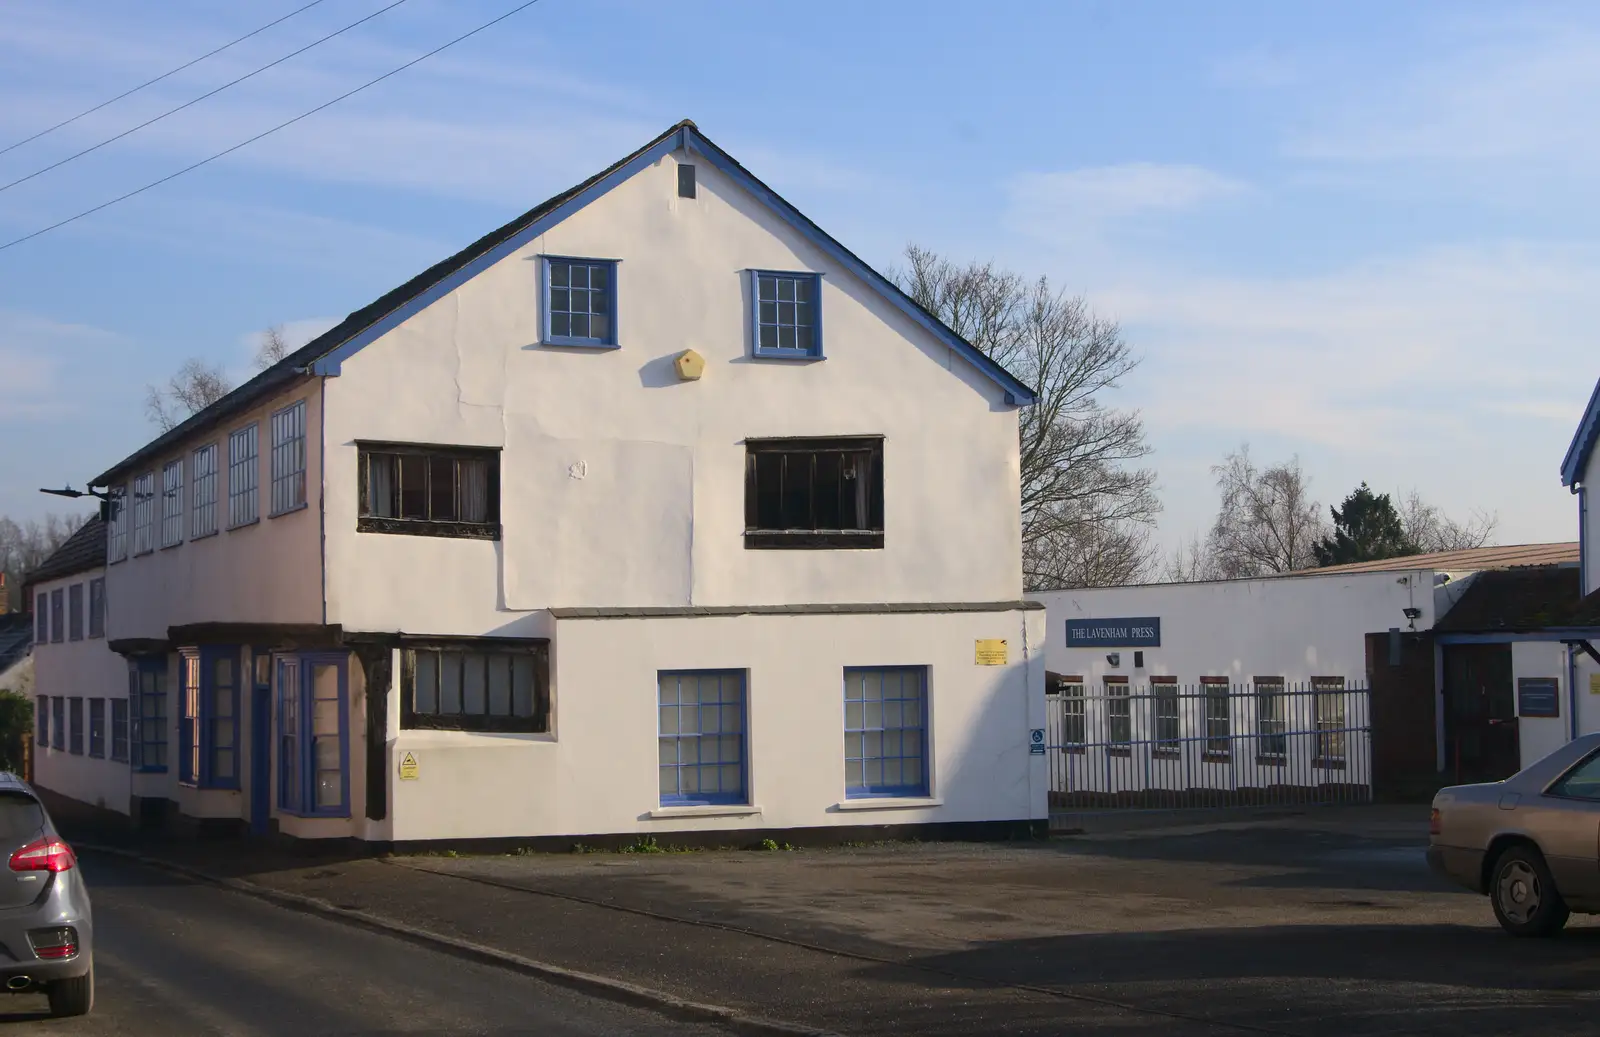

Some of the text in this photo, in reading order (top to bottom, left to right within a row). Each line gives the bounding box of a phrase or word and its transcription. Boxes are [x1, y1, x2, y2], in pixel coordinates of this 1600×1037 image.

[1072, 627, 1154, 638] THE LAVENHAM PRESS
